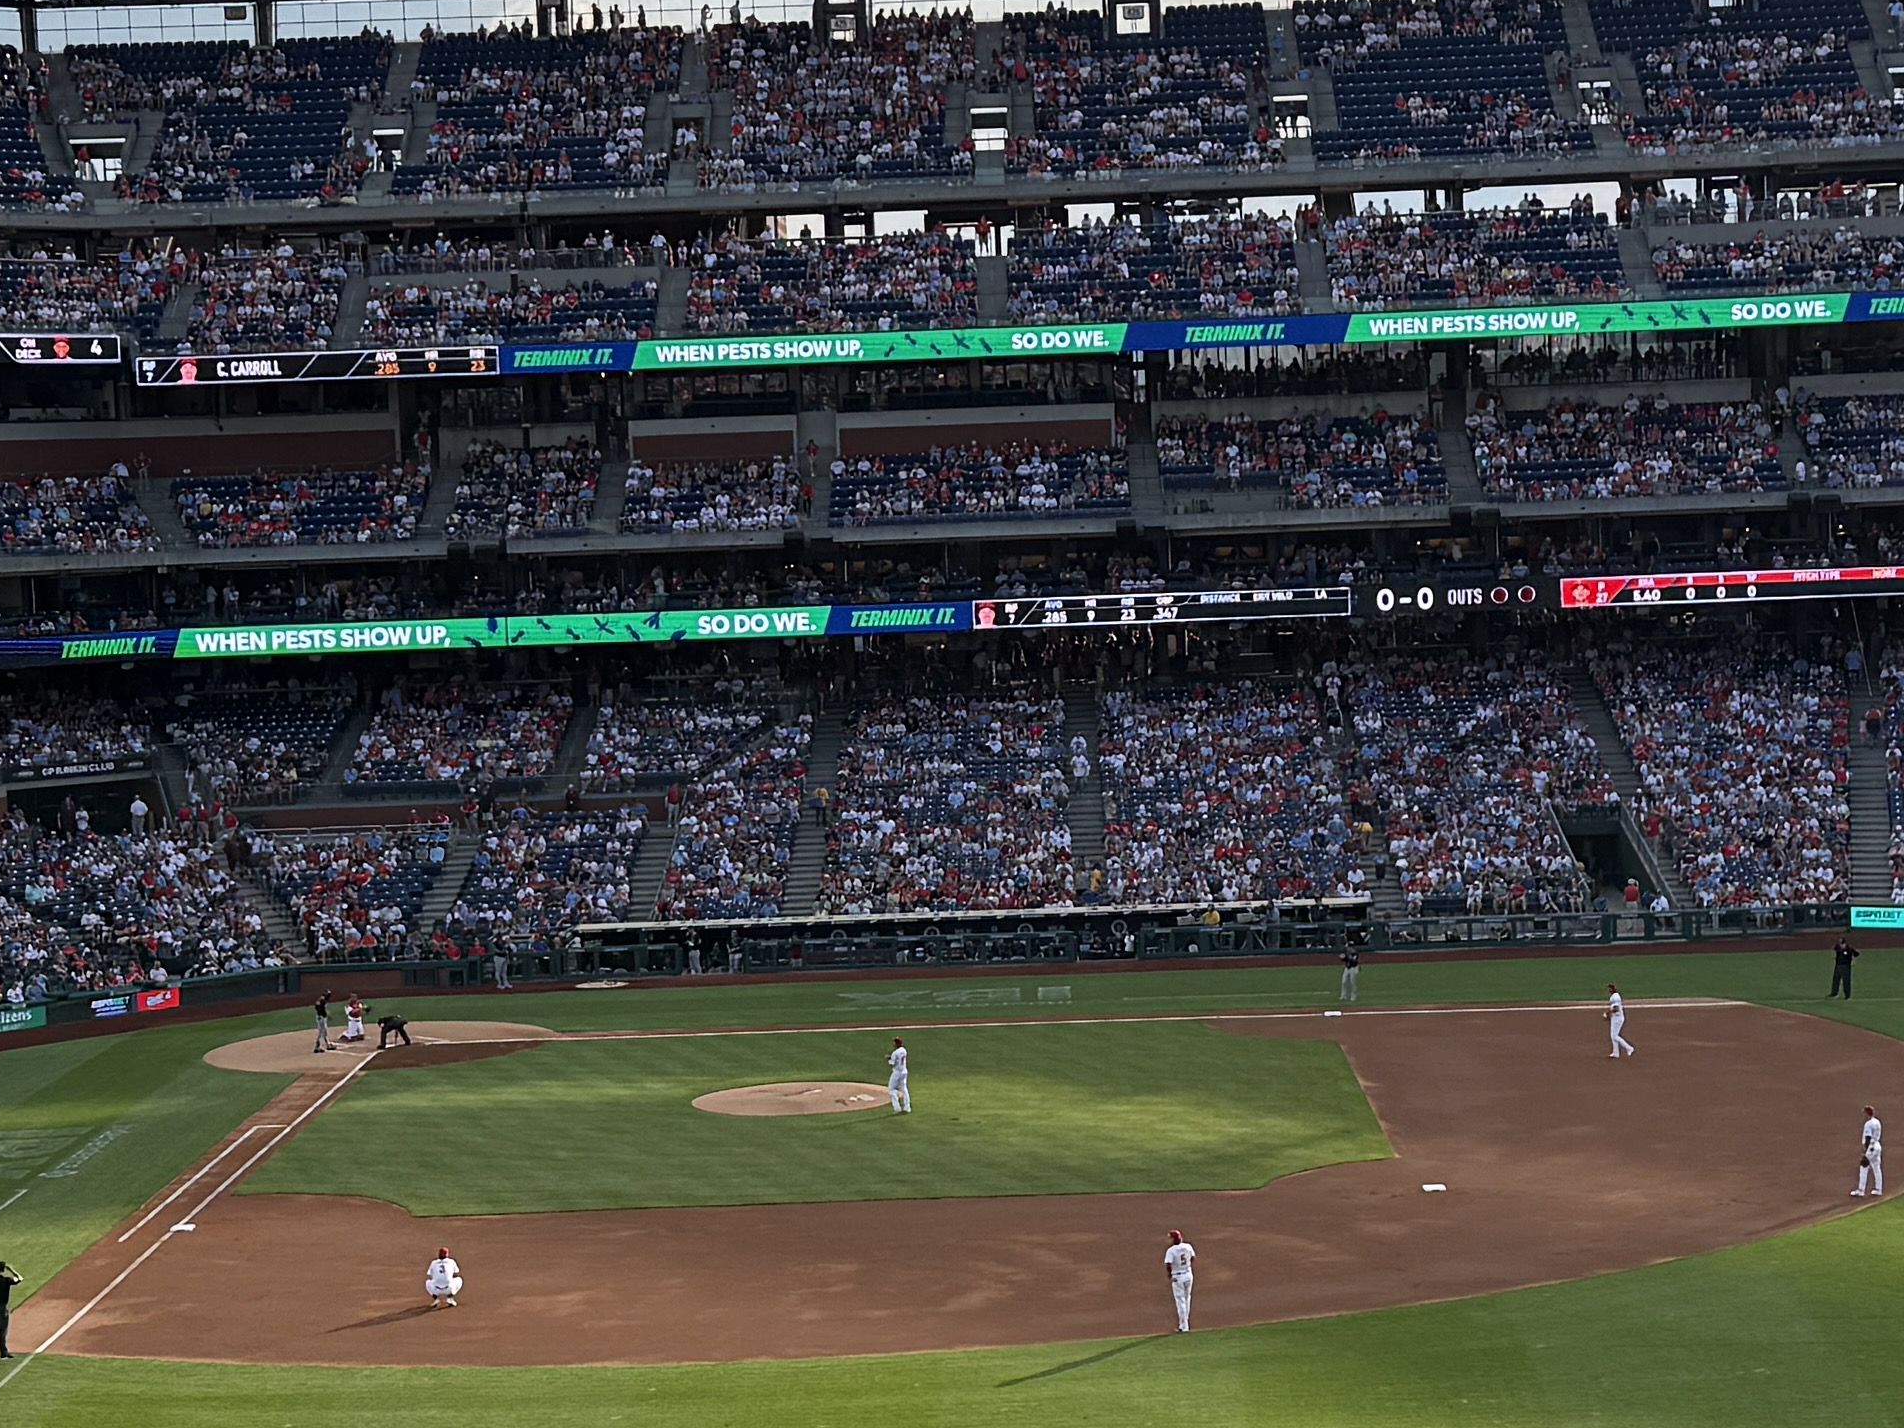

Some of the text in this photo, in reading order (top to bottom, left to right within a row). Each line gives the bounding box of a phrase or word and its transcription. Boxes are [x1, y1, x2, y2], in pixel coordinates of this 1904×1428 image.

[1731, 300, 1831, 321] SO DO WE.
[1184, 323, 1285, 343] TERMINIX IT.
[1370, 312, 1580, 336] WHEN PESTS SHOW UP,
[1011, 330, 1110, 350] SO DO WE.
[16, 349, 41, 360] DECK
[514, 348, 613, 368] TERMINIX IT.
[656, 339, 864, 362] WHEN PESTS SHOW UP,
[230, 360, 282, 377] CARROLL
[1447, 588, 1483, 605] OUTS
[698, 612, 817, 634] SO DO WE.
[850, 607, 955, 628] TERMINIX IT.
[1042, 611, 1068, 623] .285
[1086, 610, 1096, 621] 9
[1121, 608, 1136, 620] 23
[61, 636, 156, 659] TERMINIX IT.
[195, 625, 451, 653] WHEN PESTS SHOW UP,
